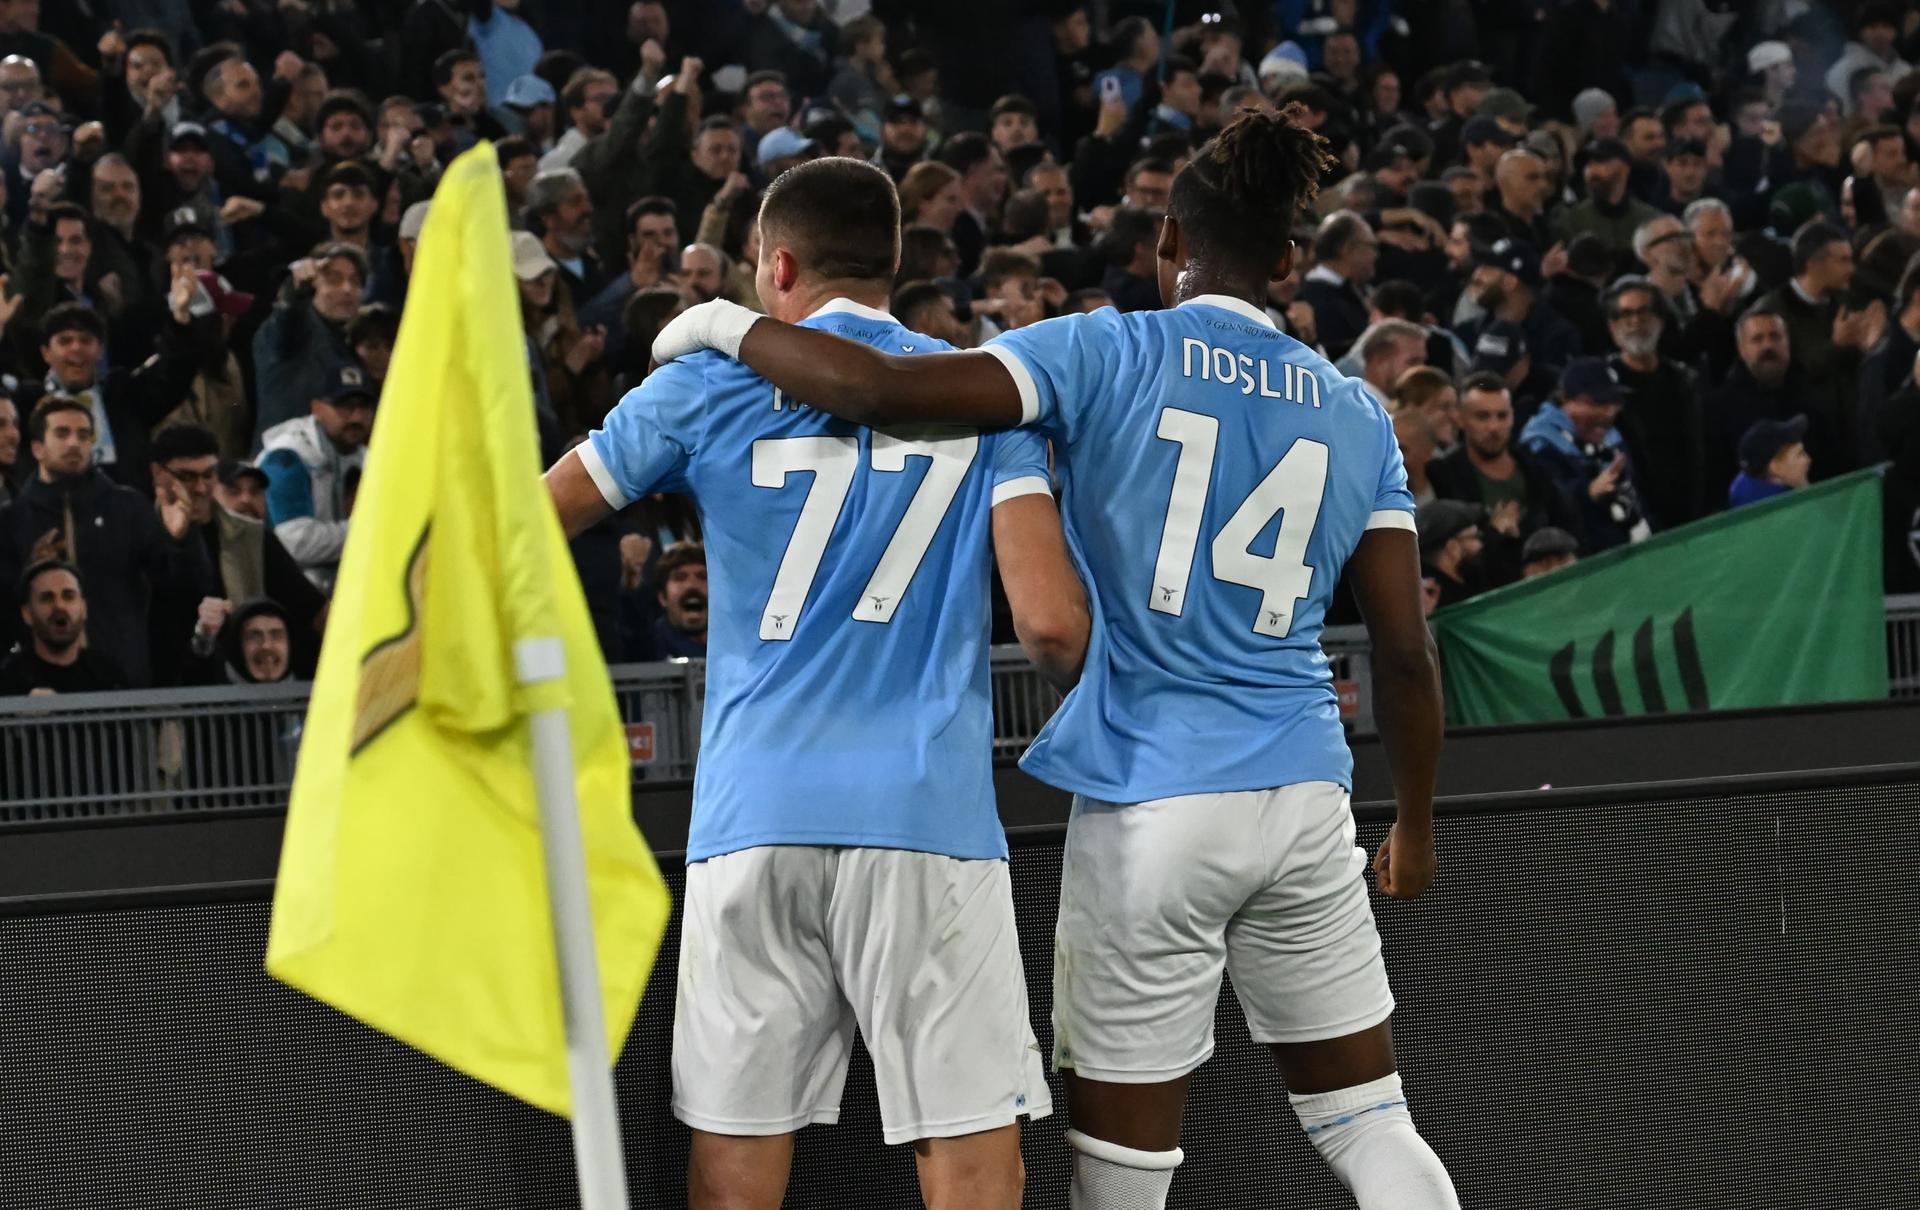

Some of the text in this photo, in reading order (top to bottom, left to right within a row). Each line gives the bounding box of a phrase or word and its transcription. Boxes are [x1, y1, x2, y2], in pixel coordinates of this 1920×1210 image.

[1182, 337, 1321, 408] NOSLIN
[1213, 321, 1258, 336] GENNAIO
[751, 430, 980, 641] 77
[1149, 407, 1330, 638] 14
